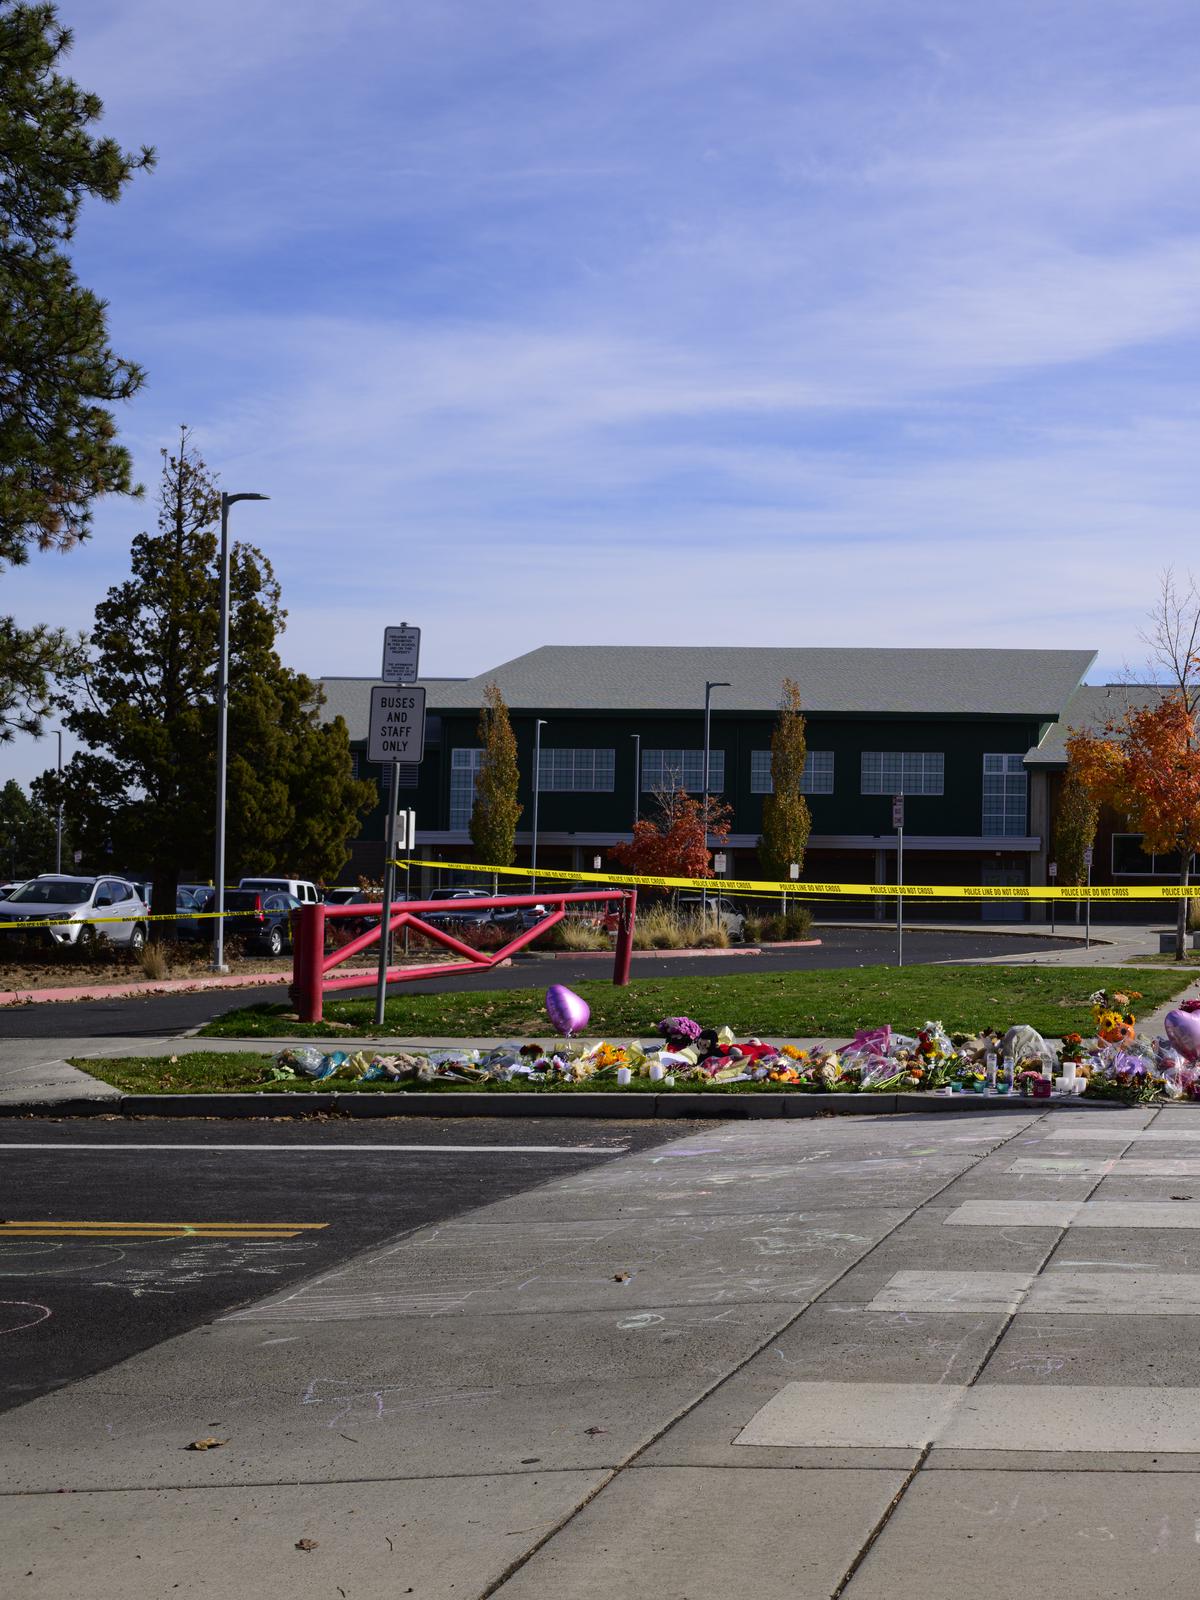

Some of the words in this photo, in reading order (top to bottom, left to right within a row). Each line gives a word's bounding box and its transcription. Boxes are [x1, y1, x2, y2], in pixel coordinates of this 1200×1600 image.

[381, 697, 415, 709] BUSES
[386, 712, 407, 723] AND
[381, 726, 412, 737] STAFF
[382, 740, 408, 752] ONLY
[779, 883, 796, 891] POLICE
[796, 884, 807, 892] LINE
[807, 884, 815, 892] DO
[825, 885, 841, 893] CROSS
[870, 886, 887, 894] POLICE
[918, 887, 934, 895] CROSS
[964, 888, 981, 896] POLICE
[982, 888, 993, 896] LINE
[994, 888, 1002, 896] DO
[1002, 888, 1013, 896] NOT
[1013, 888, 1030, 896] CROSS
[1060, 888, 1080, 896] POLICE
[1080, 888, 1091, 896] LINE
[1092, 888, 1100, 896] DO
[1100, 888, 1111, 896] NOT
[1112, 888, 1129, 896] CROSS
[1162, 887, 1181, 896] POLICE
[1182, 887, 1193, 896] LINE
